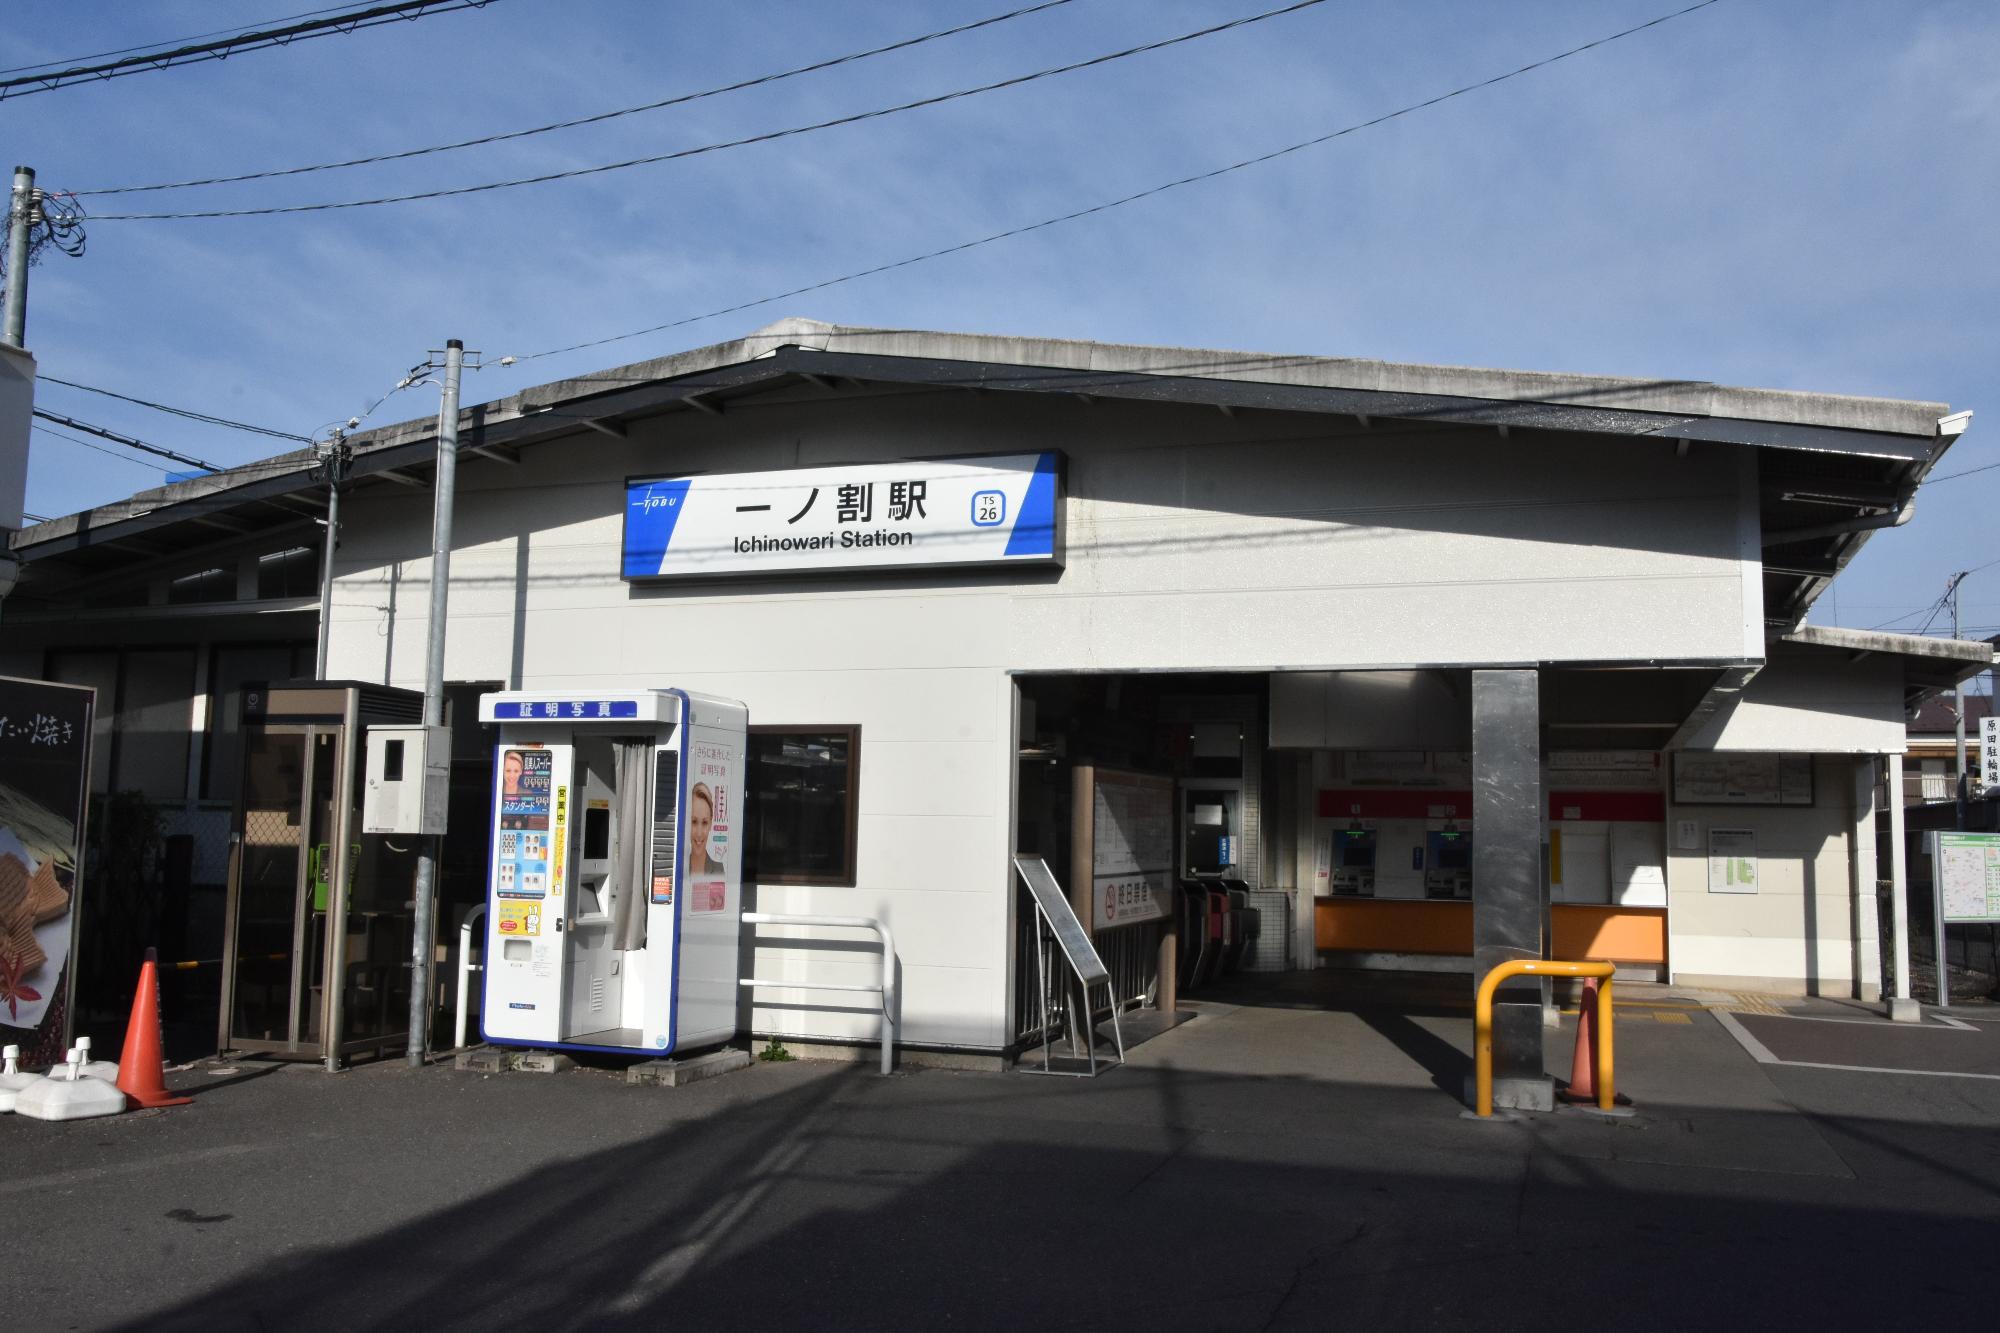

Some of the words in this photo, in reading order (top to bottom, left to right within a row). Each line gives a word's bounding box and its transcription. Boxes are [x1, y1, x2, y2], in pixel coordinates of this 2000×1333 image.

[735, 480, 926, 524] 一ノ割駅
[982, 496, 995, 505] TS
[979, 507, 997, 521] 26
[734, 531, 834, 553] Ichinowari
[840, 529, 913, 549] Station
[520, 701, 611, 717] 証明写真
[1987, 719, 1998, 784] 原田駐輪場
